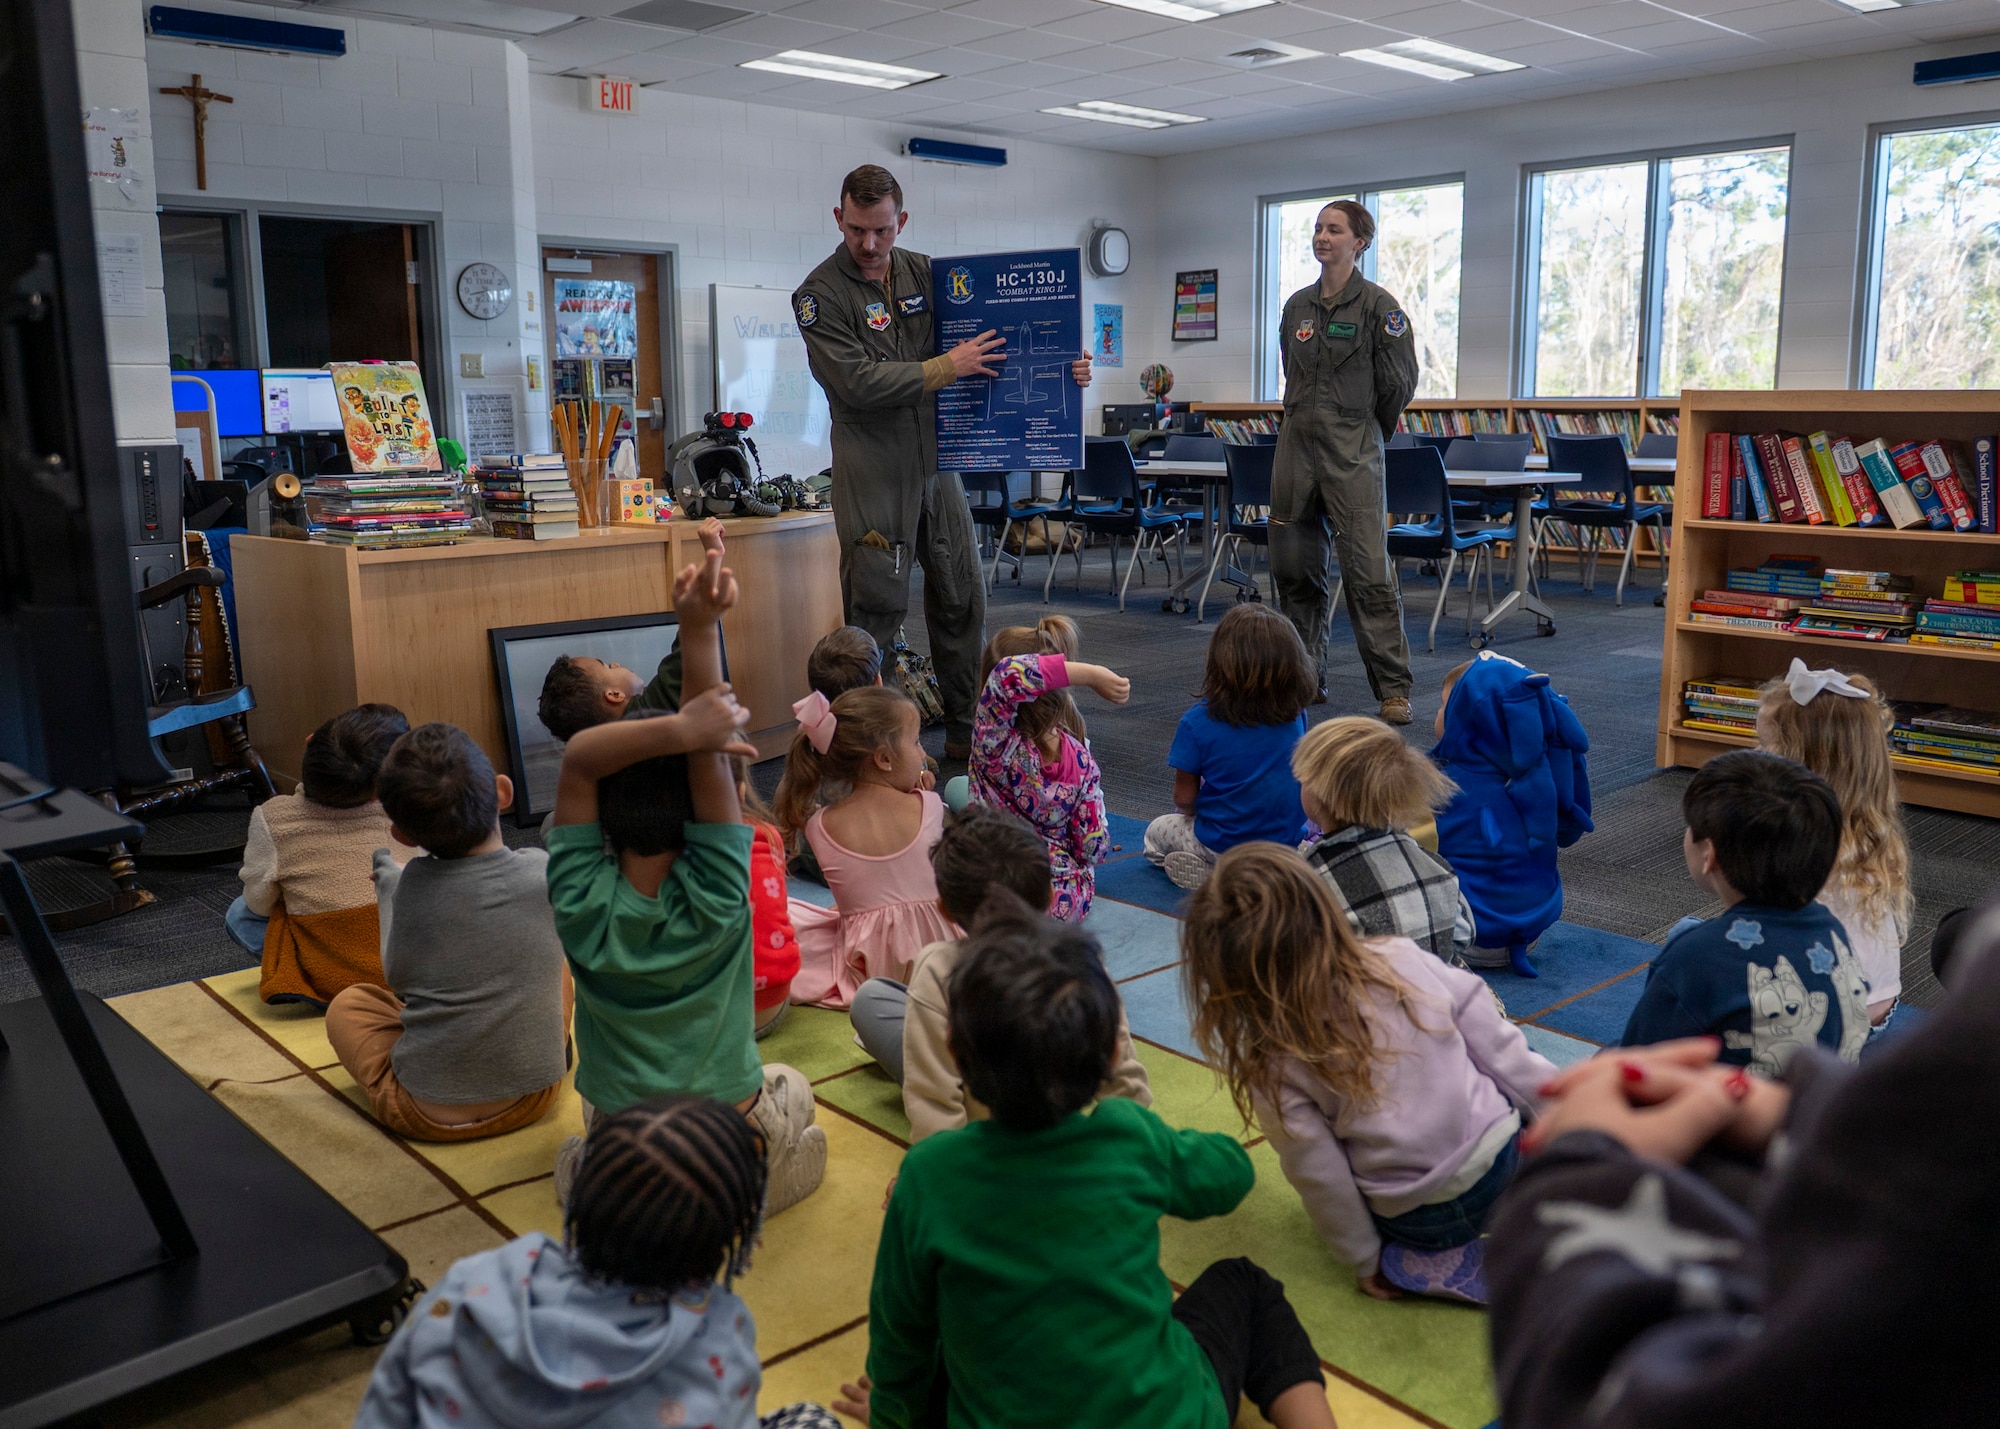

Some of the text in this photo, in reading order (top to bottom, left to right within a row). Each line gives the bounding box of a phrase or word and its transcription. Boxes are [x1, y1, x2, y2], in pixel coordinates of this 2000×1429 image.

[601, 80, 632, 111] EXIT
[996, 270, 1065, 287] HC-130J
[1096, 307, 1122, 319] READING
[1097, 354, 1120, 365] ROCKS
[363, 396, 407, 414] BUILT
[372, 422, 413, 436] LAST
[1925, 453, 1940, 476] Webster
[1708, 472, 1722, 514] WEBSTER'S
[1789, 457, 1813, 513] DICTIONARY
[1797, 456, 1818, 511] ILLUSTRATED ENGLISH
[1844, 475, 1860, 507] Dictionary
[1852, 472, 1868, 503] Children's
[1944, 475, 1963, 508] Children's
[1978, 451, 1991, 527] School Dictionary
[1935, 479, 1956, 512] Dictionary
[1840, 590, 1871, 598] ALMANAC
[1725, 617, 1773, 628] THESAURUS
[1928, 620, 1970, 629] CHILDREN'S
[1950, 616, 1993, 625] SCHOLASTIC
